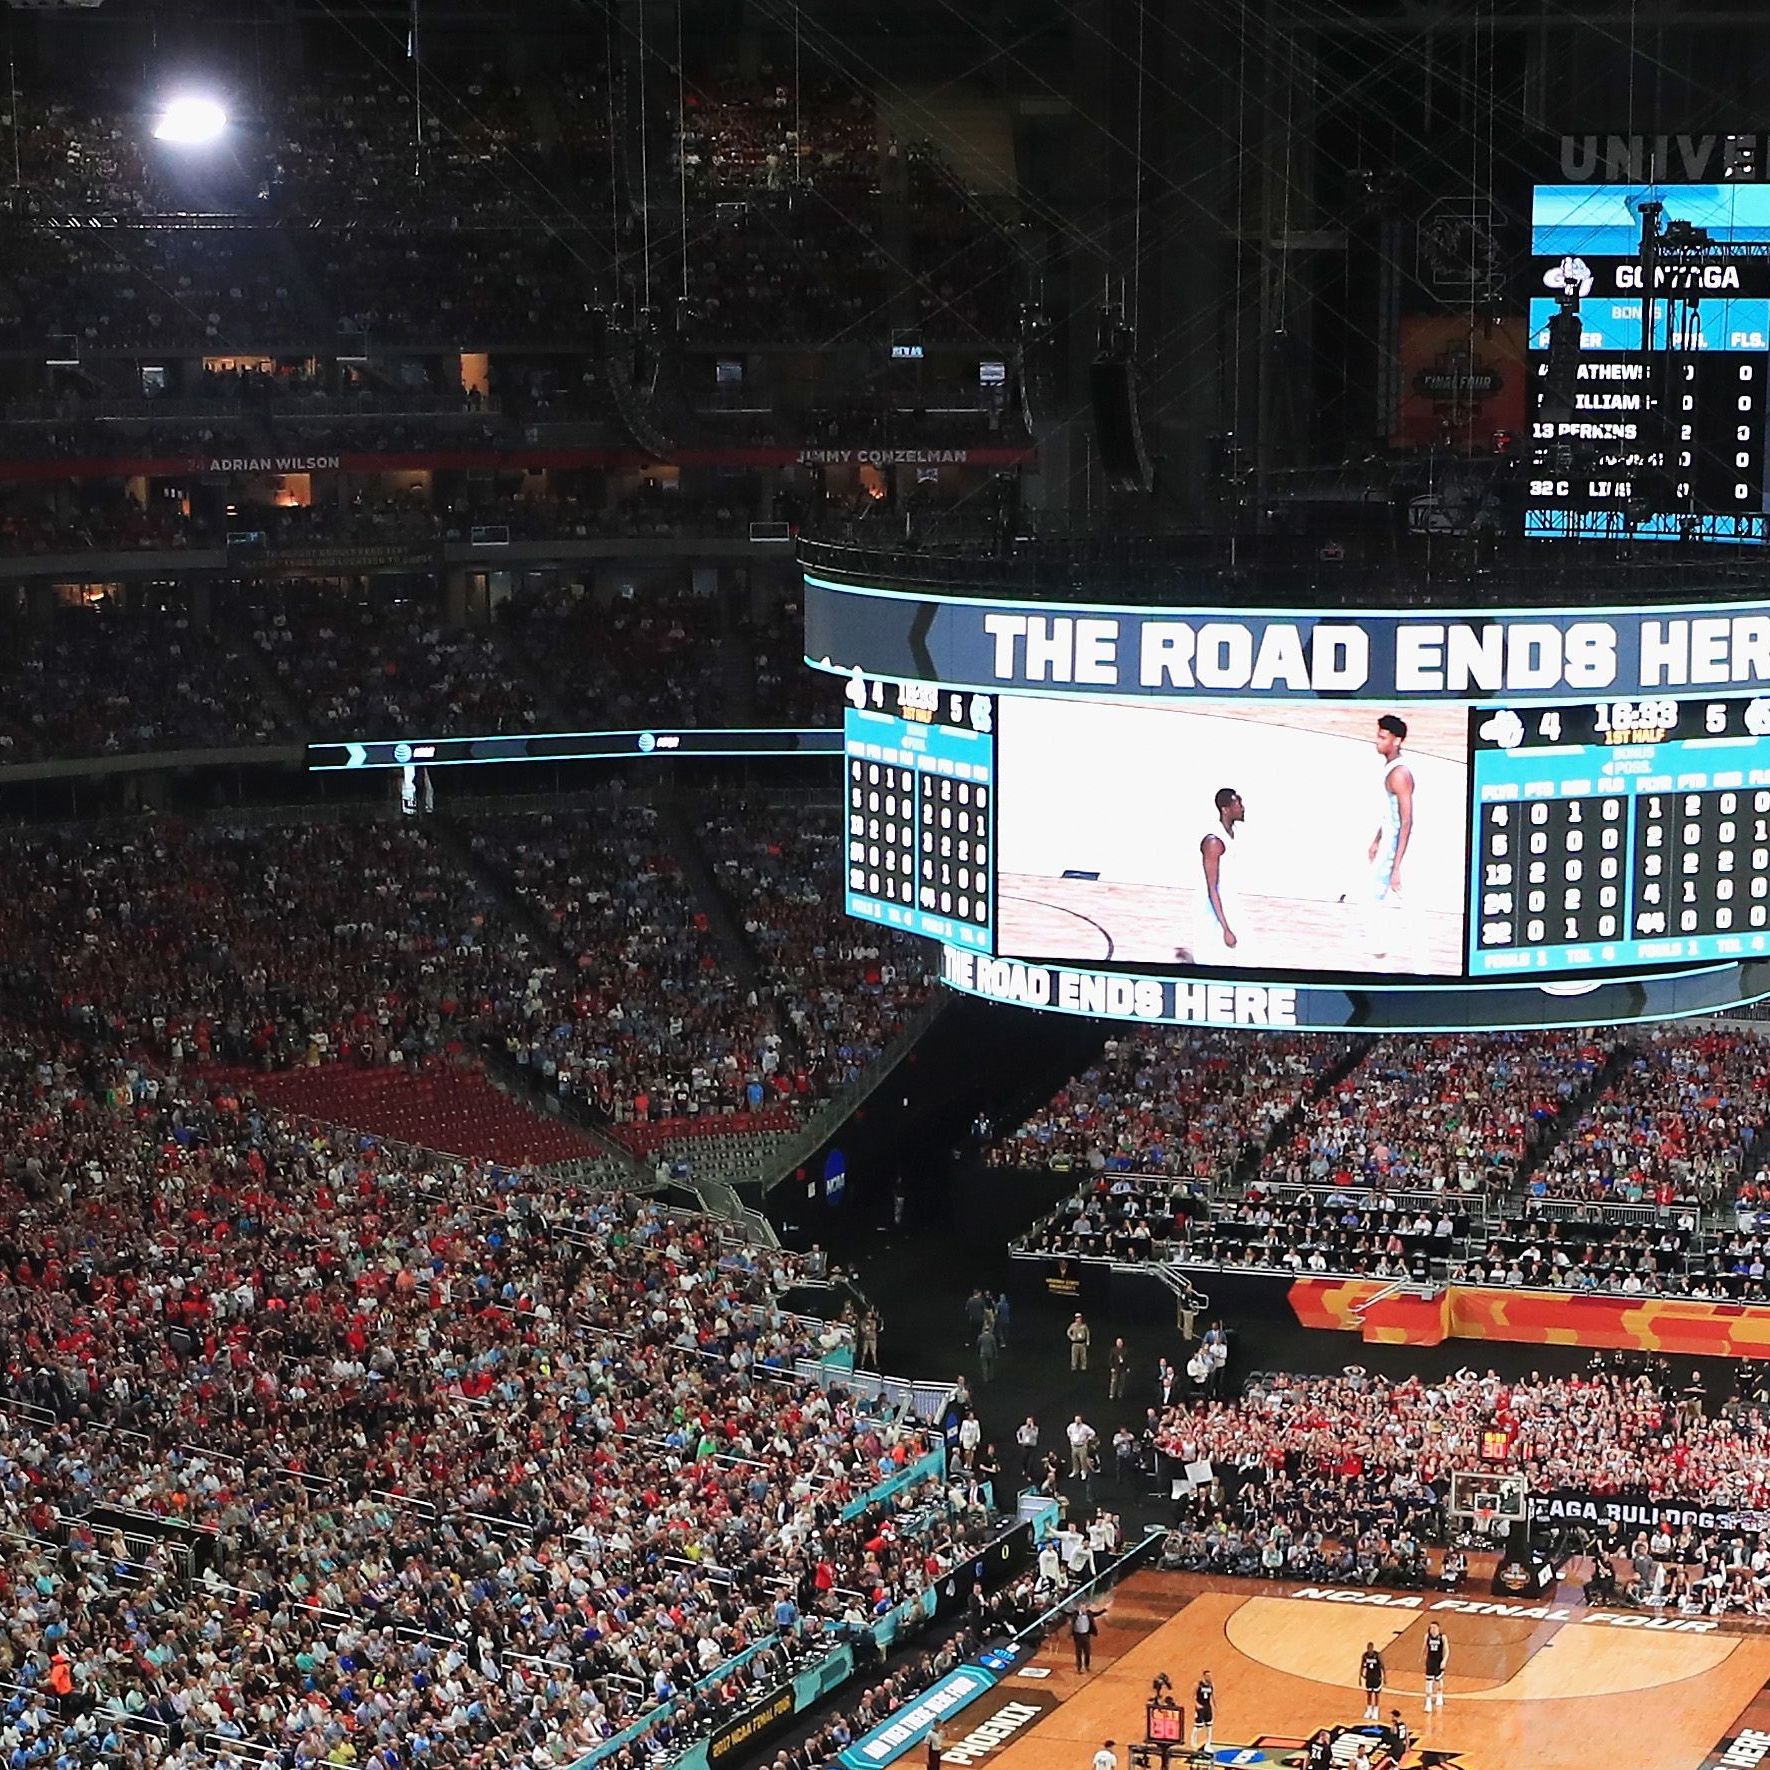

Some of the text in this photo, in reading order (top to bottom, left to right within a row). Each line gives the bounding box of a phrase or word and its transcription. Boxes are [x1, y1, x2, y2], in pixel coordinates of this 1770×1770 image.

[1612, 307, 1662, 319] BONS
[1731, 333, 1766, 348] FLS.
[1739, 366, 1752, 381] 0
[1738, 396, 1751, 411] 0
[1532, 424, 1750, 441] 13 PERKINS 2 0
[210, 458, 271, 471] ADRIAN
[275, 456, 340, 470] WILSON
[796, 450, 966, 464] JIMMY CONZELMAN
[1736, 452, 1749, 468] 0
[1530, 481, 1553, 496] 32
[1735, 484, 1748, 499] 0
[984, 613, 1119, 685] THE
[1140, 621, 1370, 691] ROAD
[1396, 622, 1618, 691] ENDS
[1539, 712, 1562, 741] 4
[1705, 704, 1727, 733] 5
[1604, 729, 1667, 744] 1ST HALF
[943, 946, 1297, 1026] THE ROAD ENDS HERE
[1291, 1587, 1719, 1634] NCAA FINAL FOUR
[940, 1700, 1044, 1766] PHOENIX
